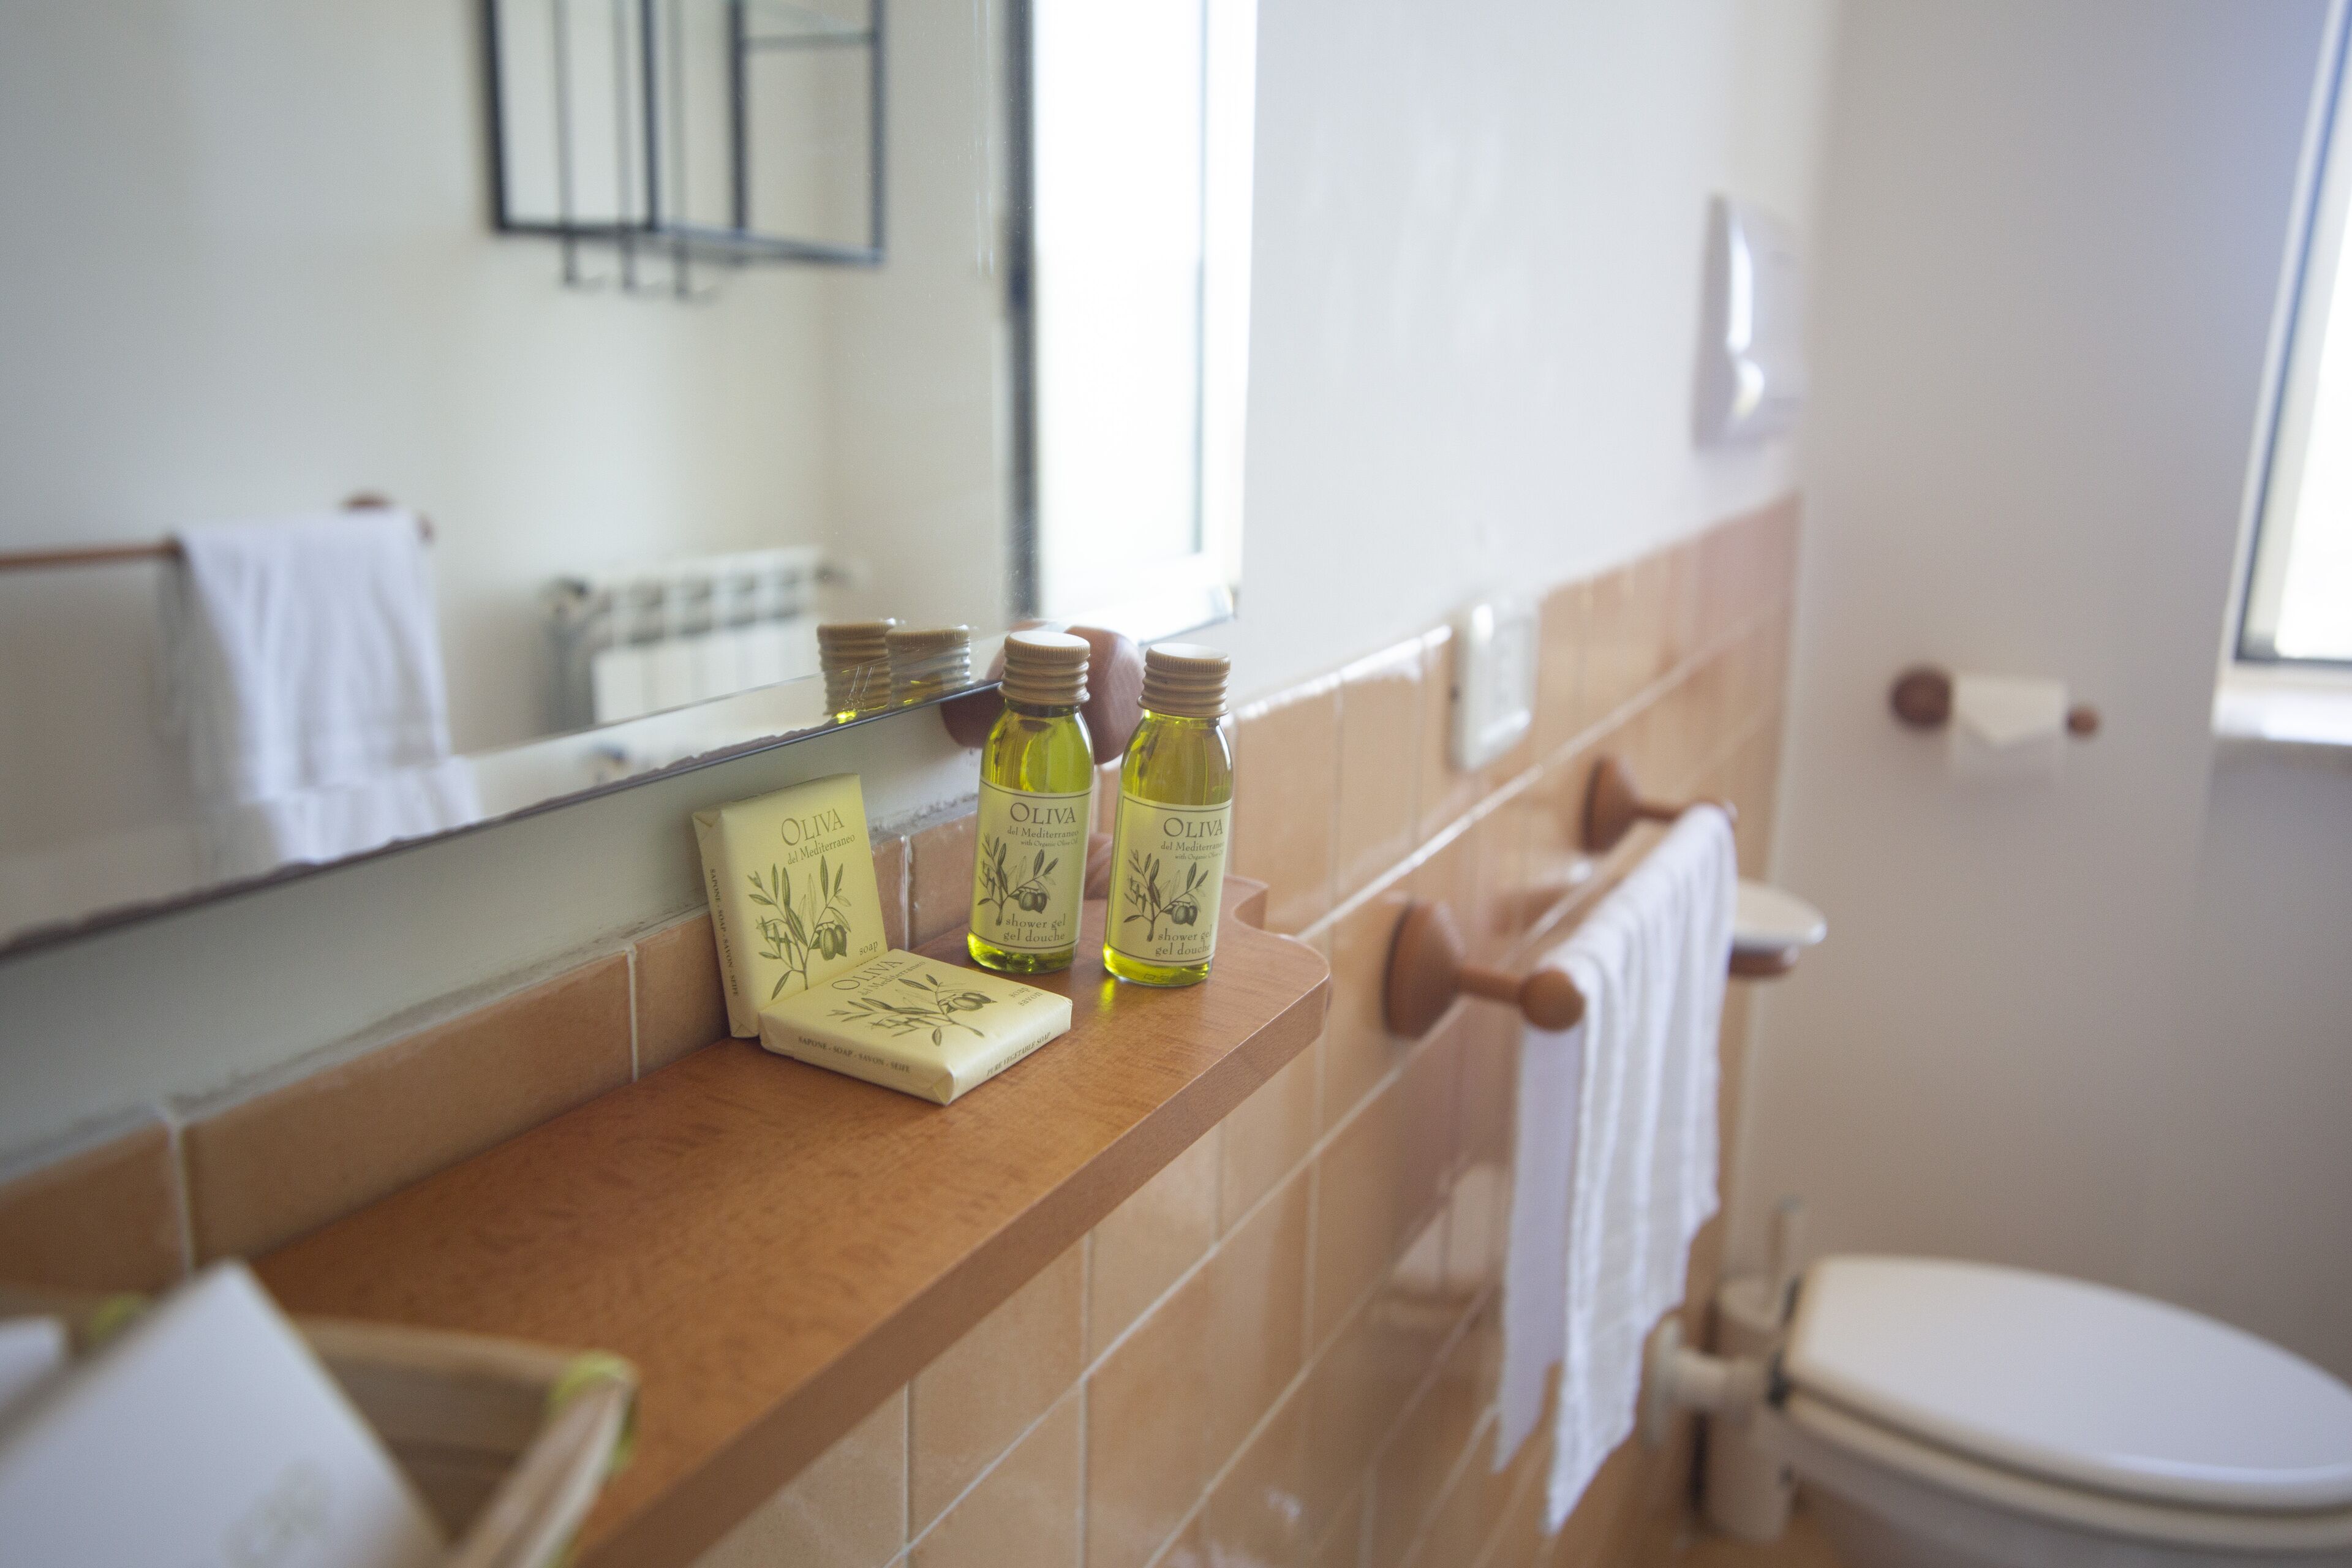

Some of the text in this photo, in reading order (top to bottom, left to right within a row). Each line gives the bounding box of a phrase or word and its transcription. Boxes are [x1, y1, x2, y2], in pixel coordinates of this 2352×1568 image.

[1010, 802, 1076, 825] OLIVA
[781, 807, 845, 846] OLIVA
[1008, 826, 1079, 839] del Mediterraneo
[1163, 817, 1224, 839] OLIVA
[788, 834, 856, 865] del Mediterraneo
[1034, 840, 1055, 848] Organic
[1161, 840, 1173, 851] del
[709, 869, 722, 903] SAPONE
[717, 910, 727, 932] SOAP
[723, 938, 734, 968] SAVON
[1005, 913, 1066, 929] shower gel
[1003, 928, 1065, 942] gel douche
[1158, 924, 1213, 941] shower gel
[859, 940, 878, 956] soap
[1155, 940, 1211, 957] gel douche
[831, 960, 905, 990] OLIVA
[857, 987, 873, 996] del
[867, 961, 926, 989] Mediterraneo
[1009, 986, 1030, 998] soap
[1017, 991, 1044, 1007] savon
[799, 1036, 827, 1050] SAPONE
[832, 1046, 853, 1057] SOAP
[1036, 1031, 1051, 1046] SOAP
